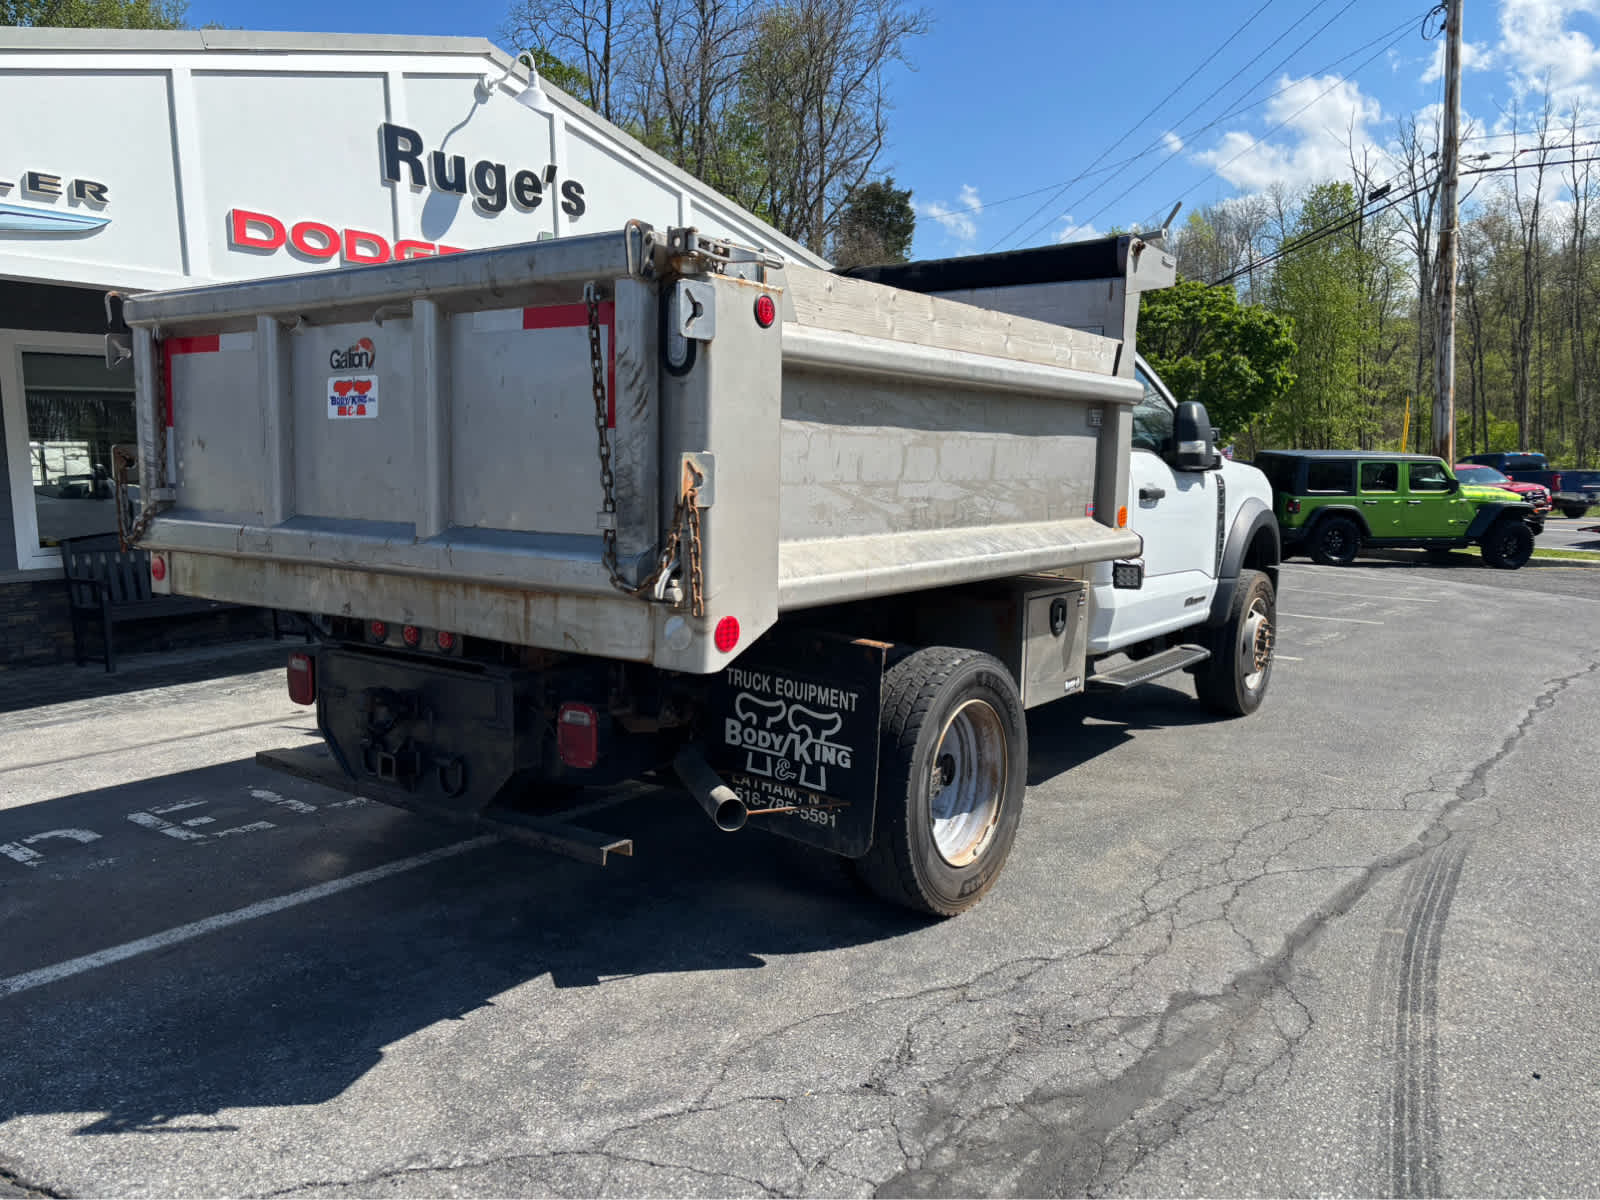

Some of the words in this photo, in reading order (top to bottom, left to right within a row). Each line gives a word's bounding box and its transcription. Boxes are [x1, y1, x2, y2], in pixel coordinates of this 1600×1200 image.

[0, 170, 111, 205] ER
[381, 121, 587, 217] Ruge's
[726, 668, 772, 693] TRUCK
[775, 676, 859, 712] EQUIPMENT
